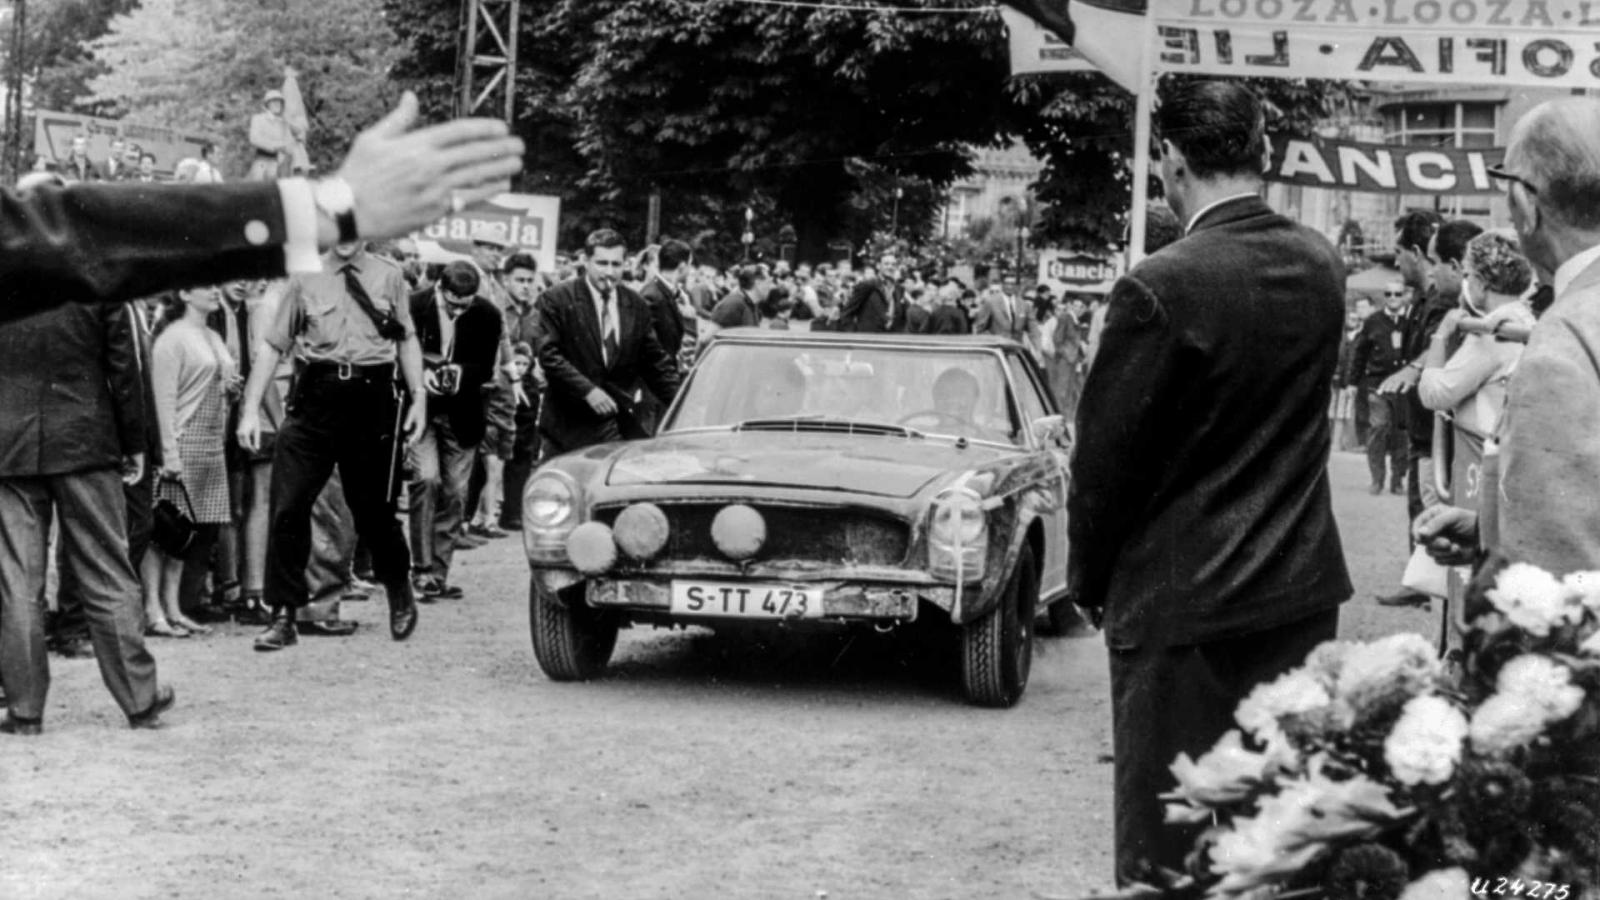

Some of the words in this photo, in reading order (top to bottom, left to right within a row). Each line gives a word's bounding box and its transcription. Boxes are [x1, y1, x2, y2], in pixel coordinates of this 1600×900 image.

[1383, 0, 1554, 26] LOOZA
[1279, 139, 1508, 192] ANCI
[1049, 261, 1115, 281] Gancia
[686, 586, 751, 613] S-TT
[761, 590, 809, 617] 473
